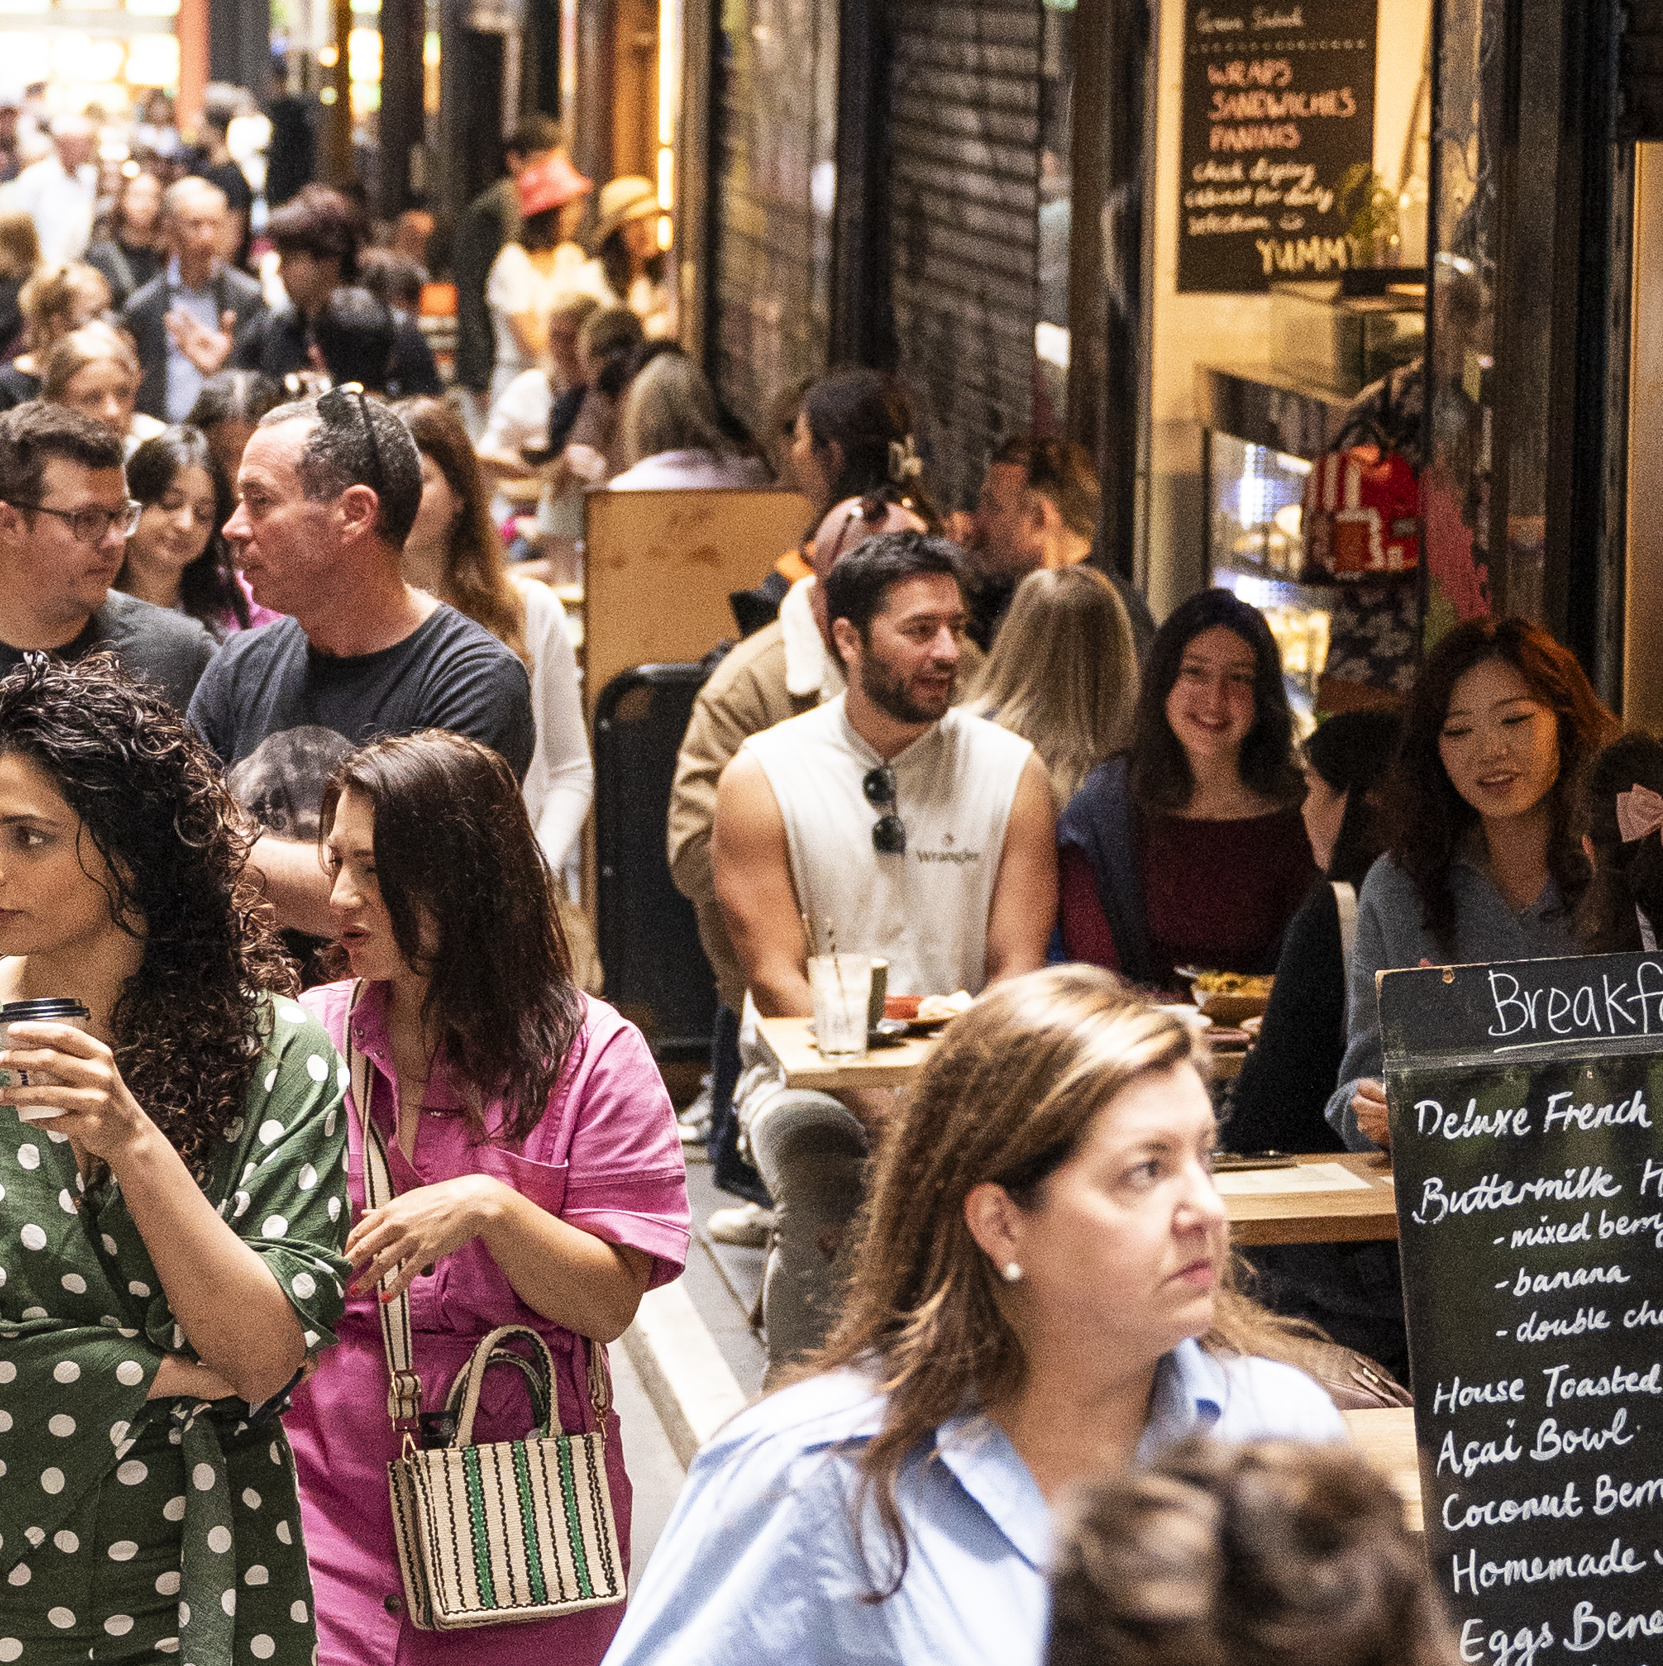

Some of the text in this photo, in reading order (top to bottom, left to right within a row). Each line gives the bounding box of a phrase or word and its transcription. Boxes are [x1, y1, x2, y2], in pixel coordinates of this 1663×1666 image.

[1208, 86, 1357, 121] SANDWICHES
[1414, 1090, 1652, 1140] Deluxe French
[1412, 1165, 1623, 1224] Buttermilk
[1433, 1363, 1663, 1414] House Toasted
[1530, 1407, 1634, 1461] Bowl
[1442, 1482, 1584, 1531] Coconut
[1452, 1538, 1647, 1595] Homemade
